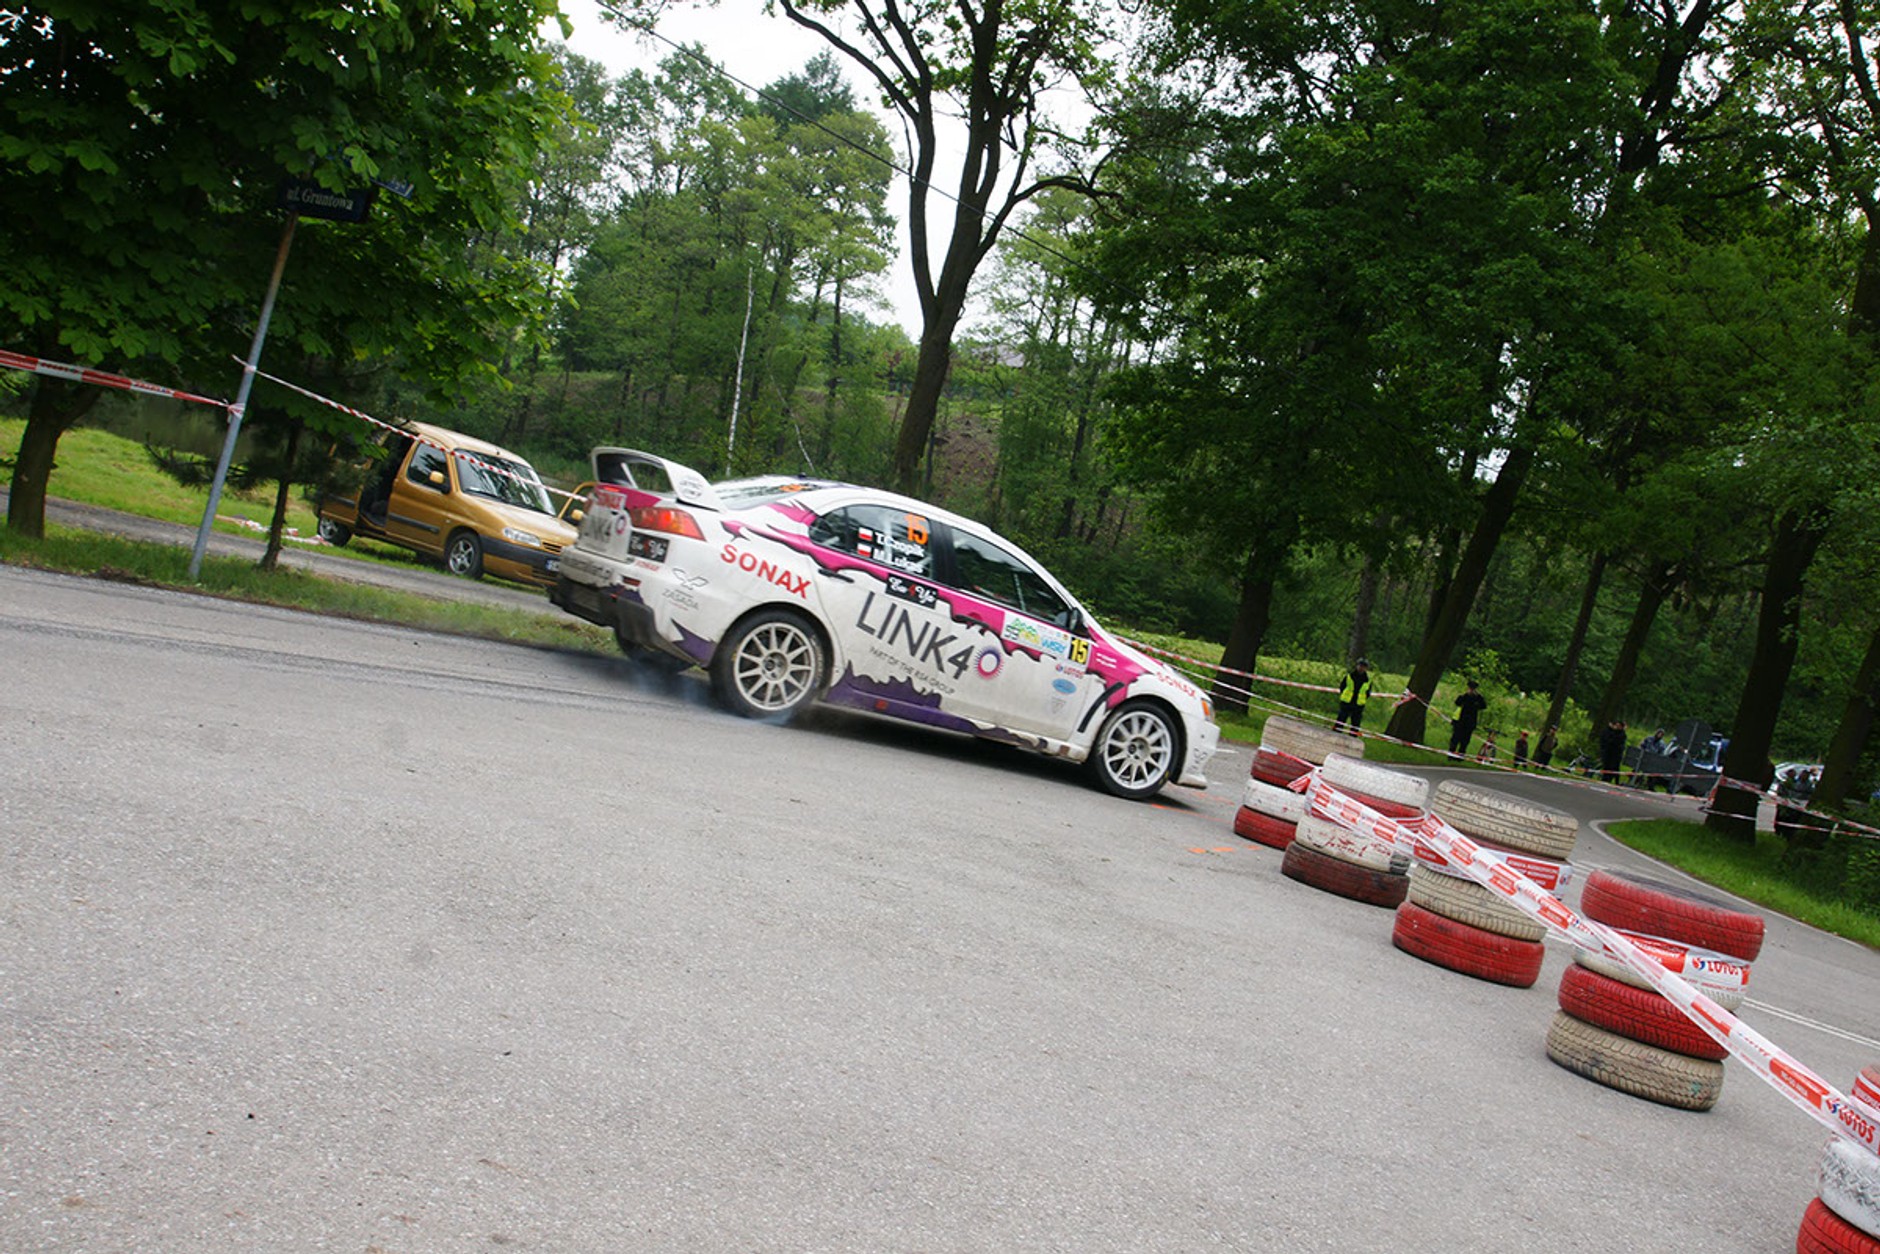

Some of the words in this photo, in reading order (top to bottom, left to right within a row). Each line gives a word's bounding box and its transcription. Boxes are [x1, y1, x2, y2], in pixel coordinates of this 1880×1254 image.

[720, 543, 811, 599] SONAX
[856, 590, 975, 680] LINK4
[1071, 638, 1088, 665] 15
